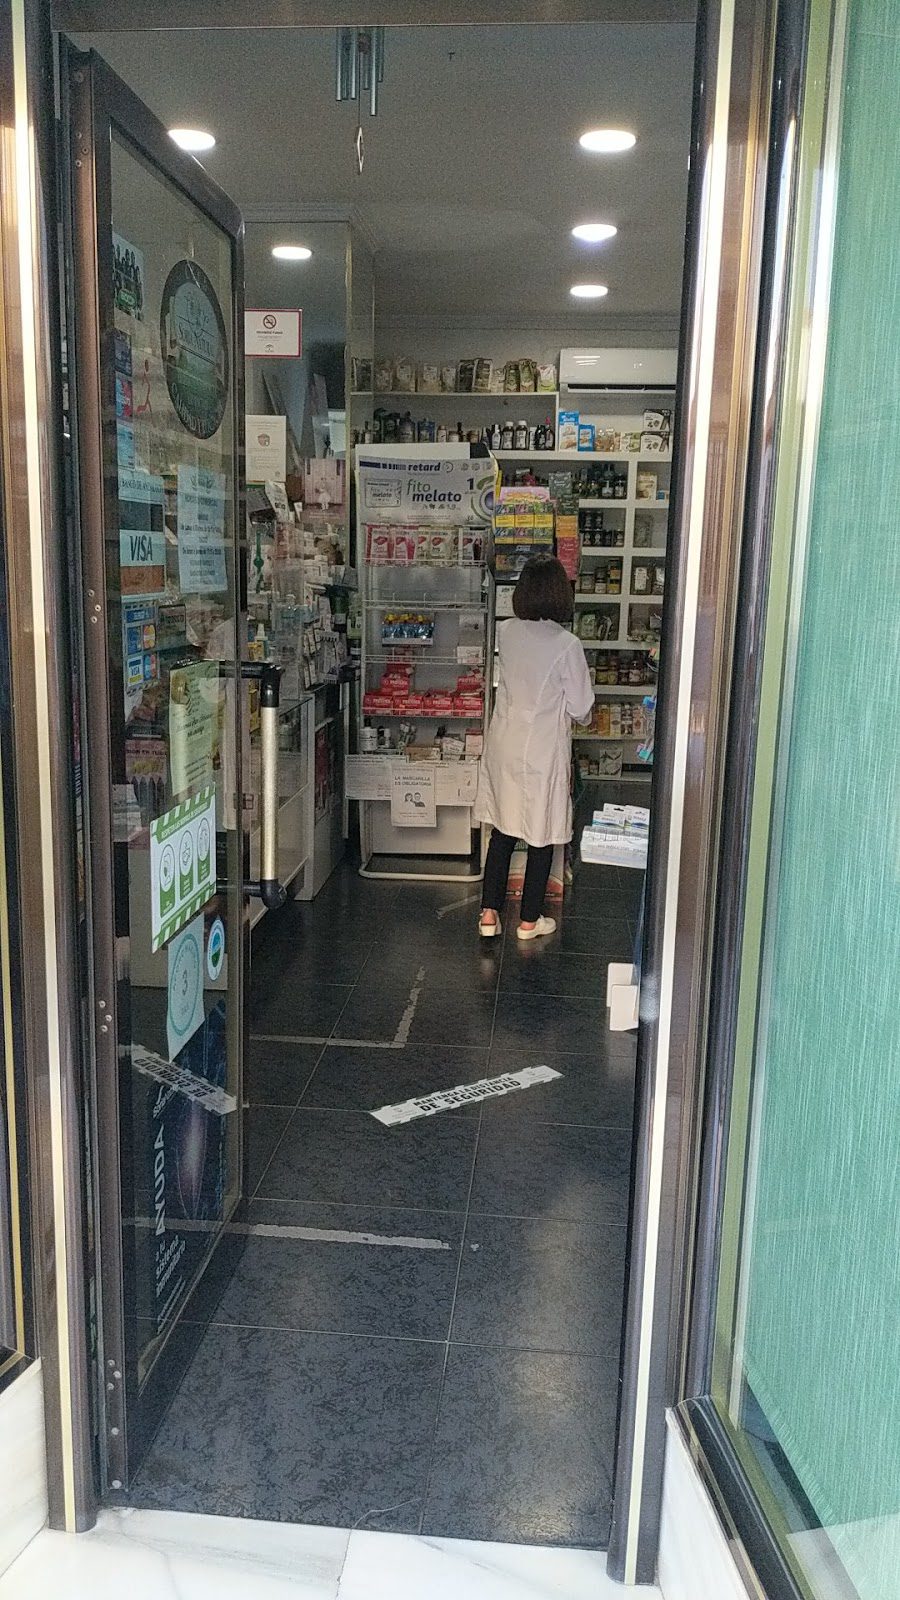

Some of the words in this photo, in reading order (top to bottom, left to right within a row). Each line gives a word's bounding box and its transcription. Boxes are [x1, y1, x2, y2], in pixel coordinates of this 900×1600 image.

[407, 461, 441, 472] retard
[406, 478, 431, 495] fito
[466, 477, 474, 490] 1
[412, 489, 462, 502] melato
[129, 535, 153, 561] VISA
[413, 1090, 459, 1106] MANTENGA
[458, 1087, 471, 1096] LA
[471, 1077, 513, 1091] DISTANCIA
[419, 1101, 442, 1112] DE
[443, 1080, 522, 1104] SEGURIDAD
[154, 1122, 166, 1236] AYUDA
